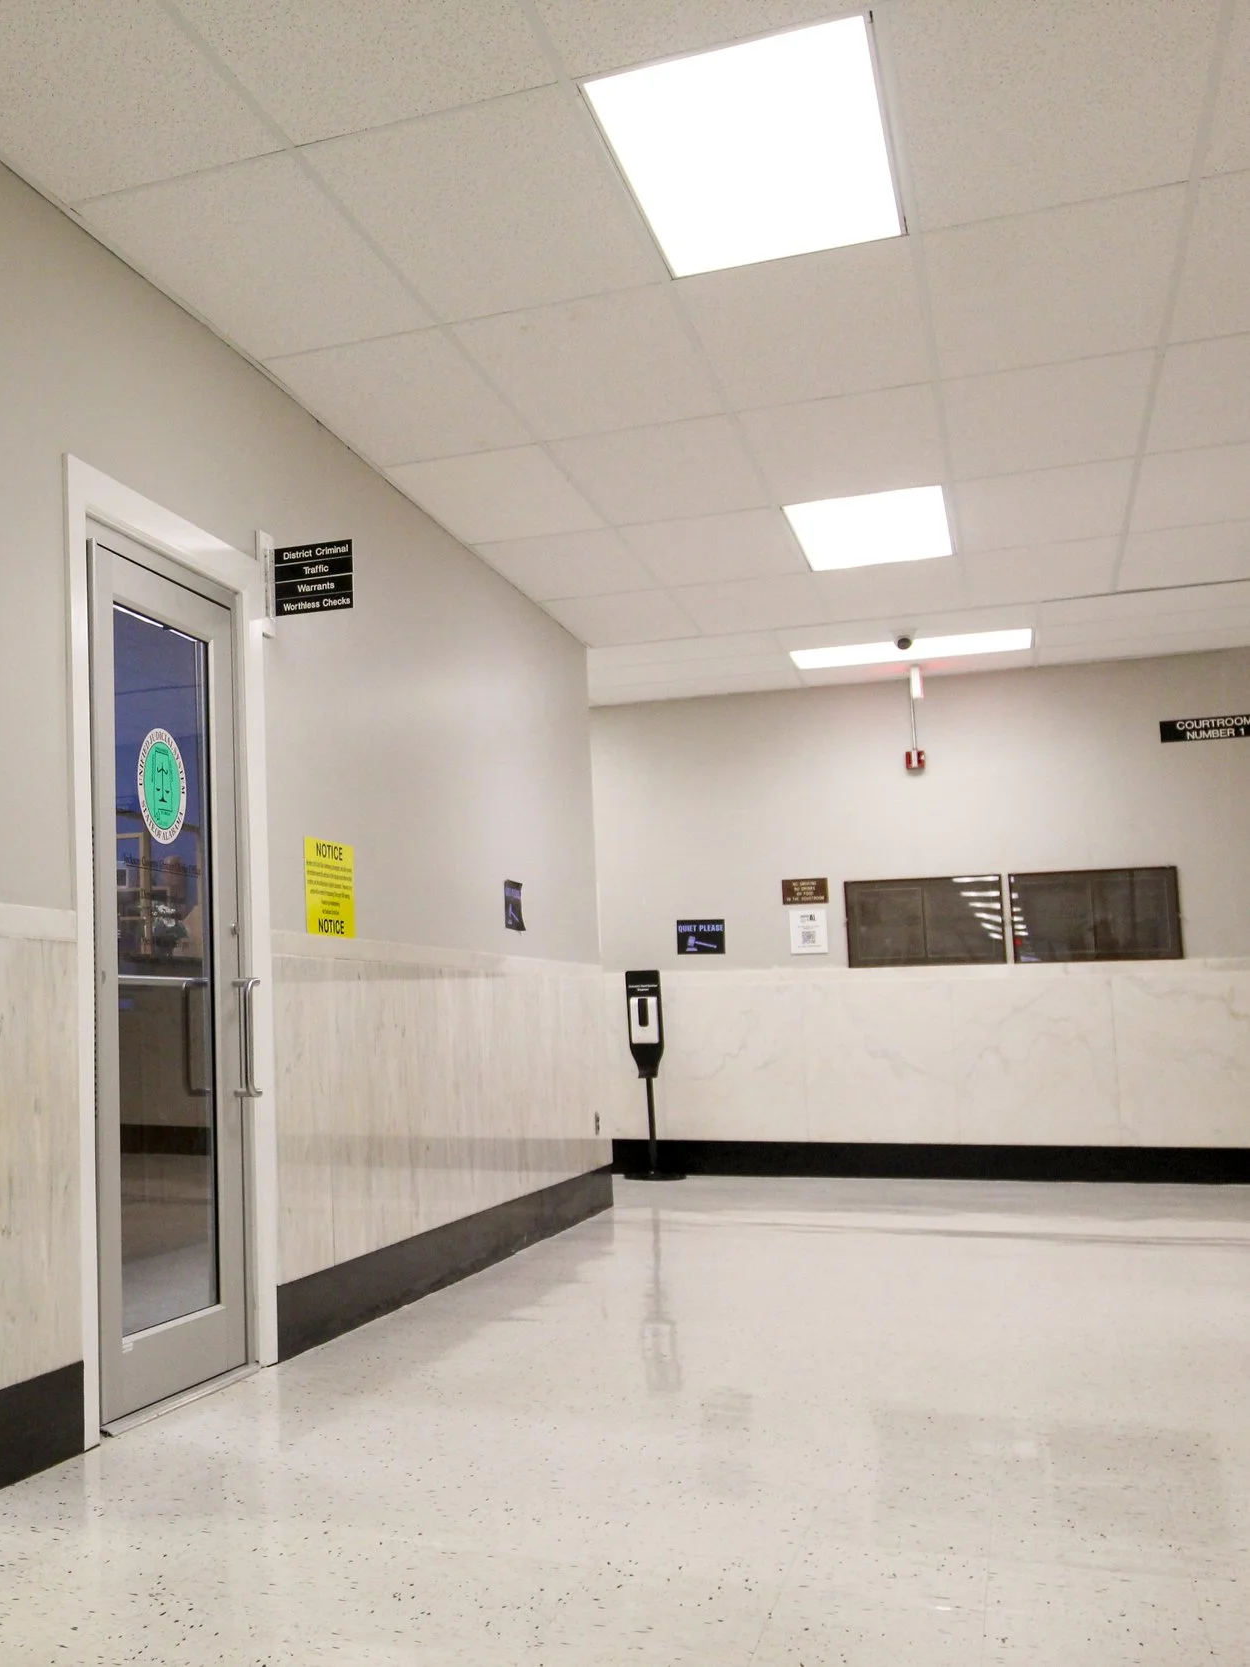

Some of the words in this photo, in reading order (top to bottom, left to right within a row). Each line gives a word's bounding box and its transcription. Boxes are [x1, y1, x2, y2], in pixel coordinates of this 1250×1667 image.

[283, 549, 312, 560] District
[315, 544, 349, 556] Criminal
[303, 565, 329, 575] Traffic
[297, 582, 335, 593] Warrants
[283, 601, 320, 612] Worthless
[322, 597, 351, 607] Checks
[1186, 728, 1235, 740] NUMBER
[1239, 727, 1245, 736] 1
[316, 842, 343, 861] NOTICE
[318, 918, 345, 935] NOTICE
[678, 925, 696, 933] QUIET
[699, 924, 723, 932] PLEASE
